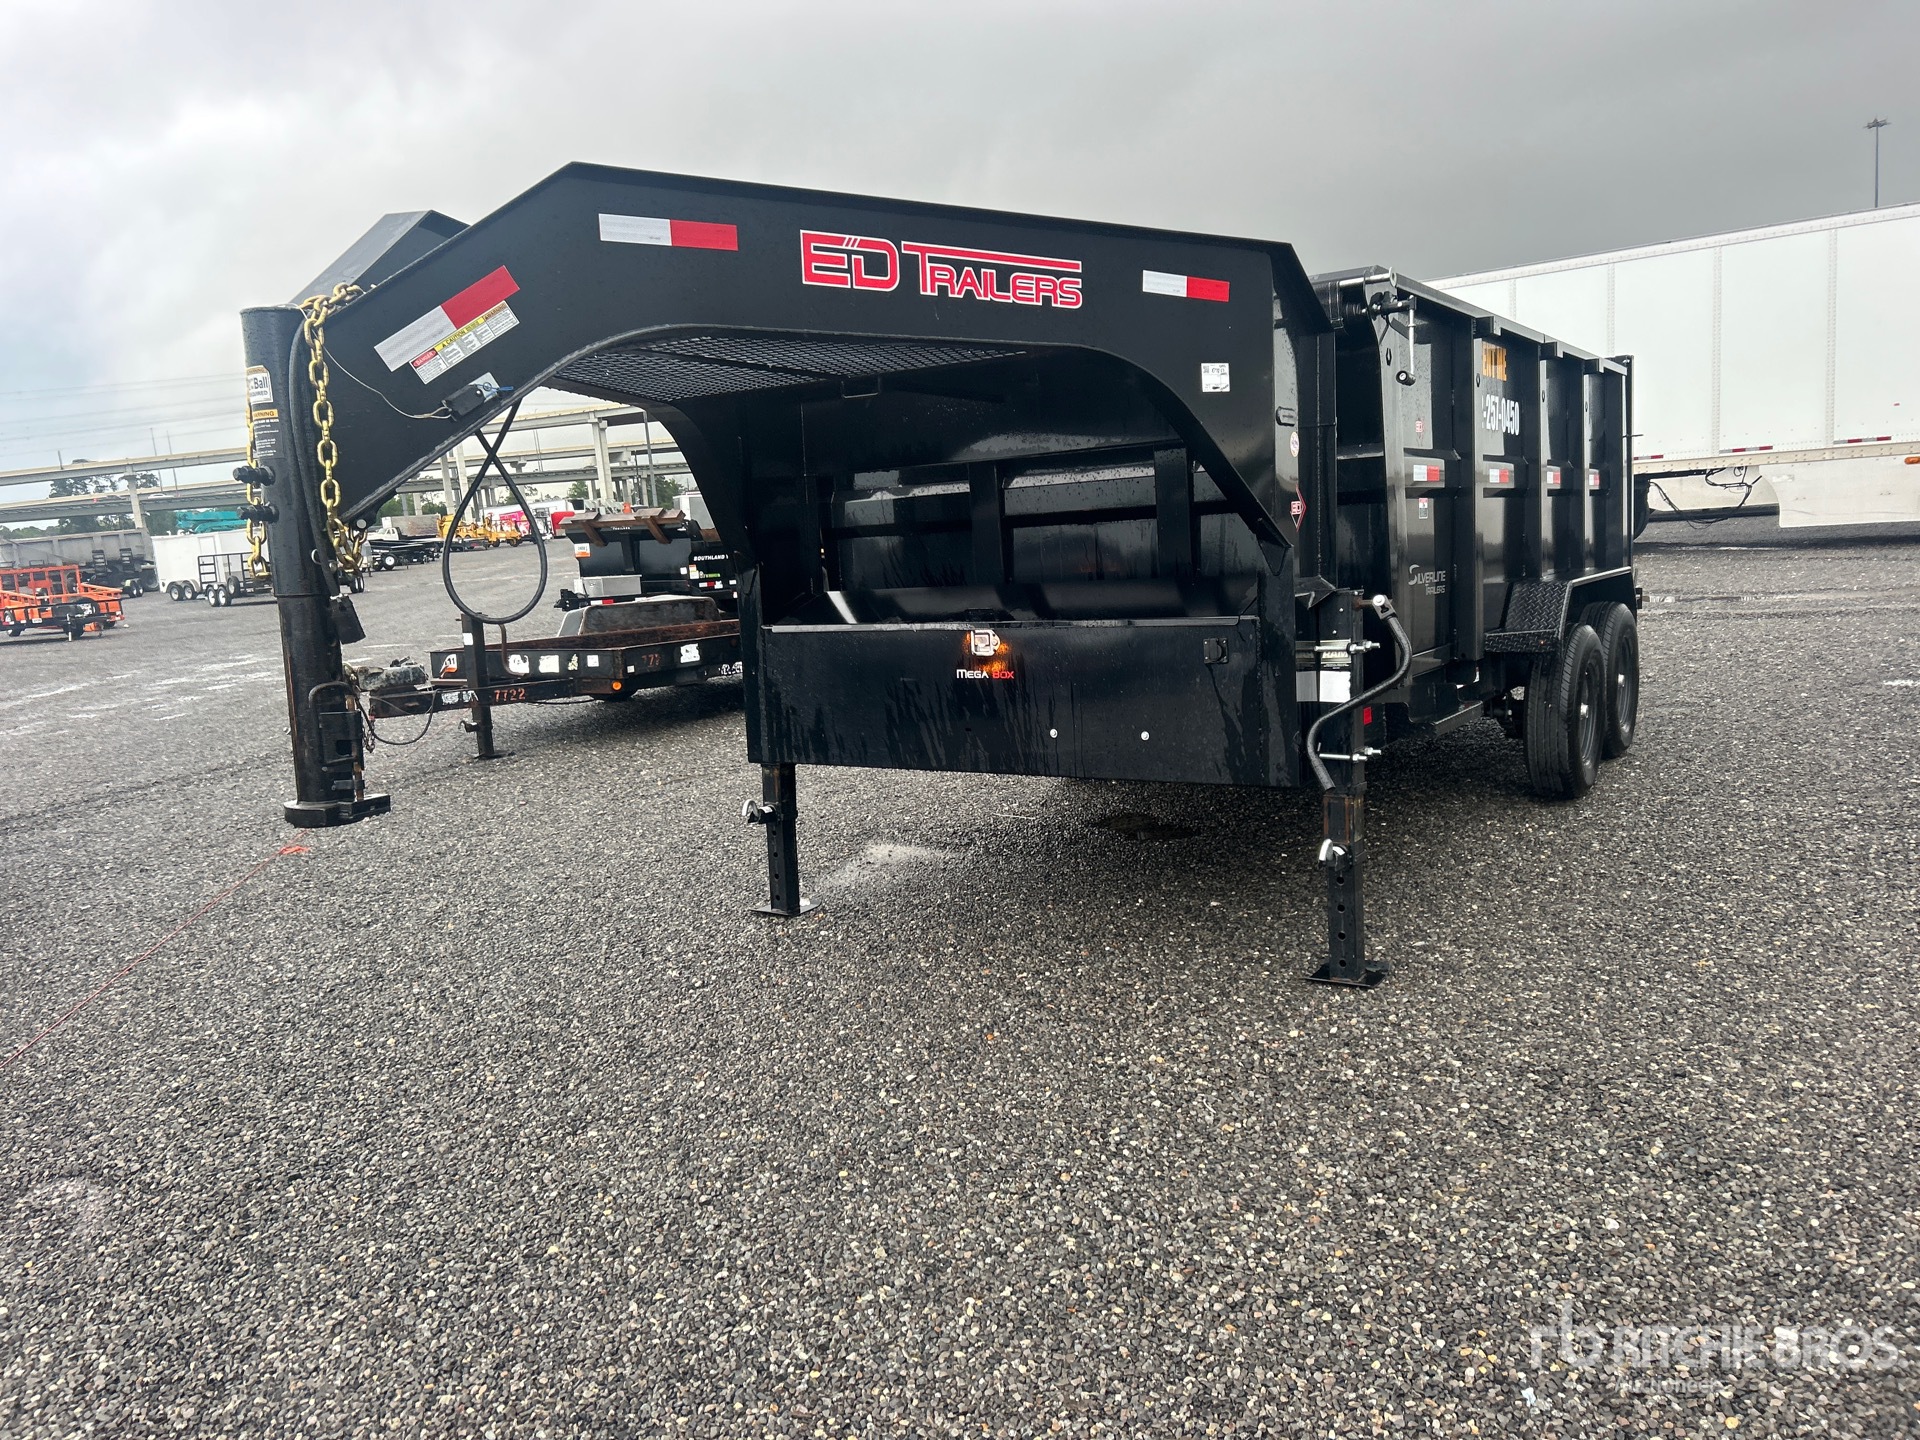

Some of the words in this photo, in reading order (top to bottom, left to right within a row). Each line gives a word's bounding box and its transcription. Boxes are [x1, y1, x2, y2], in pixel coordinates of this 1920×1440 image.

[800, 230, 899, 292] ED
[901, 241, 1082, 309] TRAILERS
[253, 376, 269, 390] Ball
[1482, 394, 1520, 436] -257-0450
[693, 554, 726, 562] SOUTHLAND
[1408, 564, 1446, 586] SILVERLINE
[1425, 583, 1446, 596] TRAILERS
[956, 668, 989, 680] MEGA
[992, 670, 1015, 680] BOX
[494, 688, 527, 703] 7722
